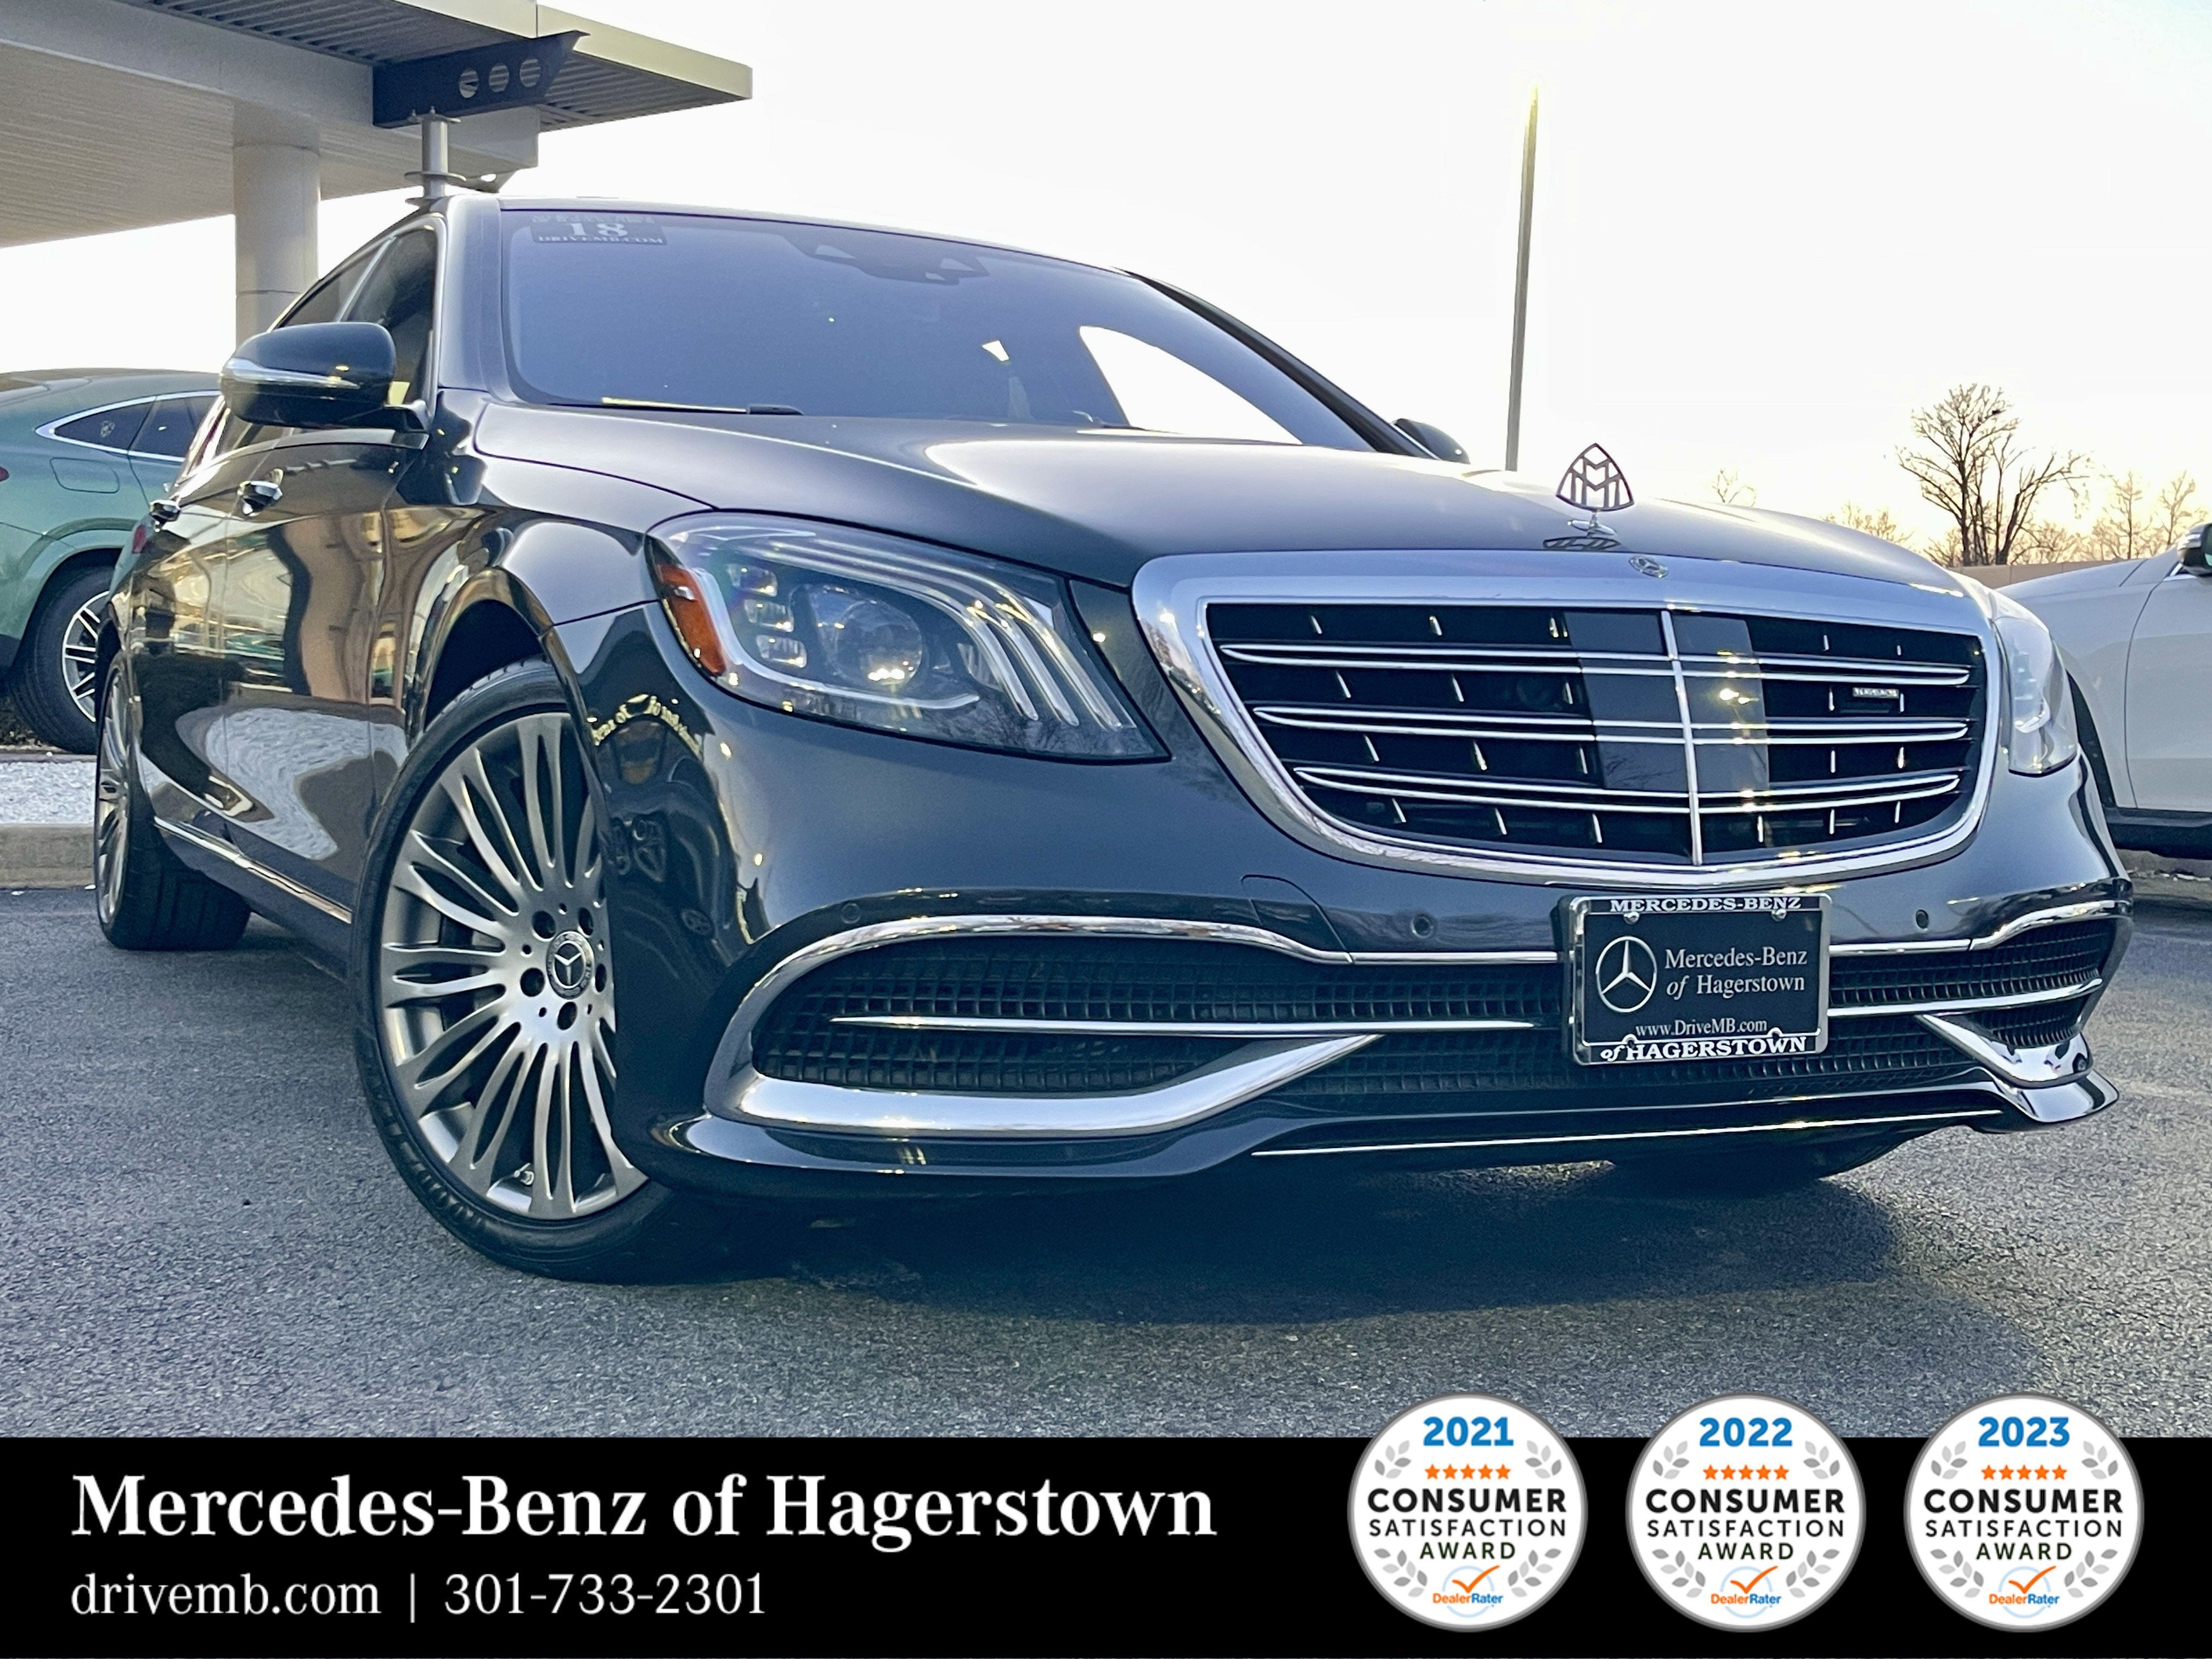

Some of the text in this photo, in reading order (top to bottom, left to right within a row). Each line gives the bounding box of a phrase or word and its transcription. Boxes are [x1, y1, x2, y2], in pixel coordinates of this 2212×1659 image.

[571, 222, 628, 236] 18
[1610, 896, 1802, 912] MERCEDES-BENZ
[1664, 946, 1808, 969] Mercedes-Benz
[1666, 975, 1805, 1000] of Hagerstown
[1635, 1018, 1768, 1036] www.DriveMB.com
[1600, 1036, 1807, 1061] of HAGERSTOWN
